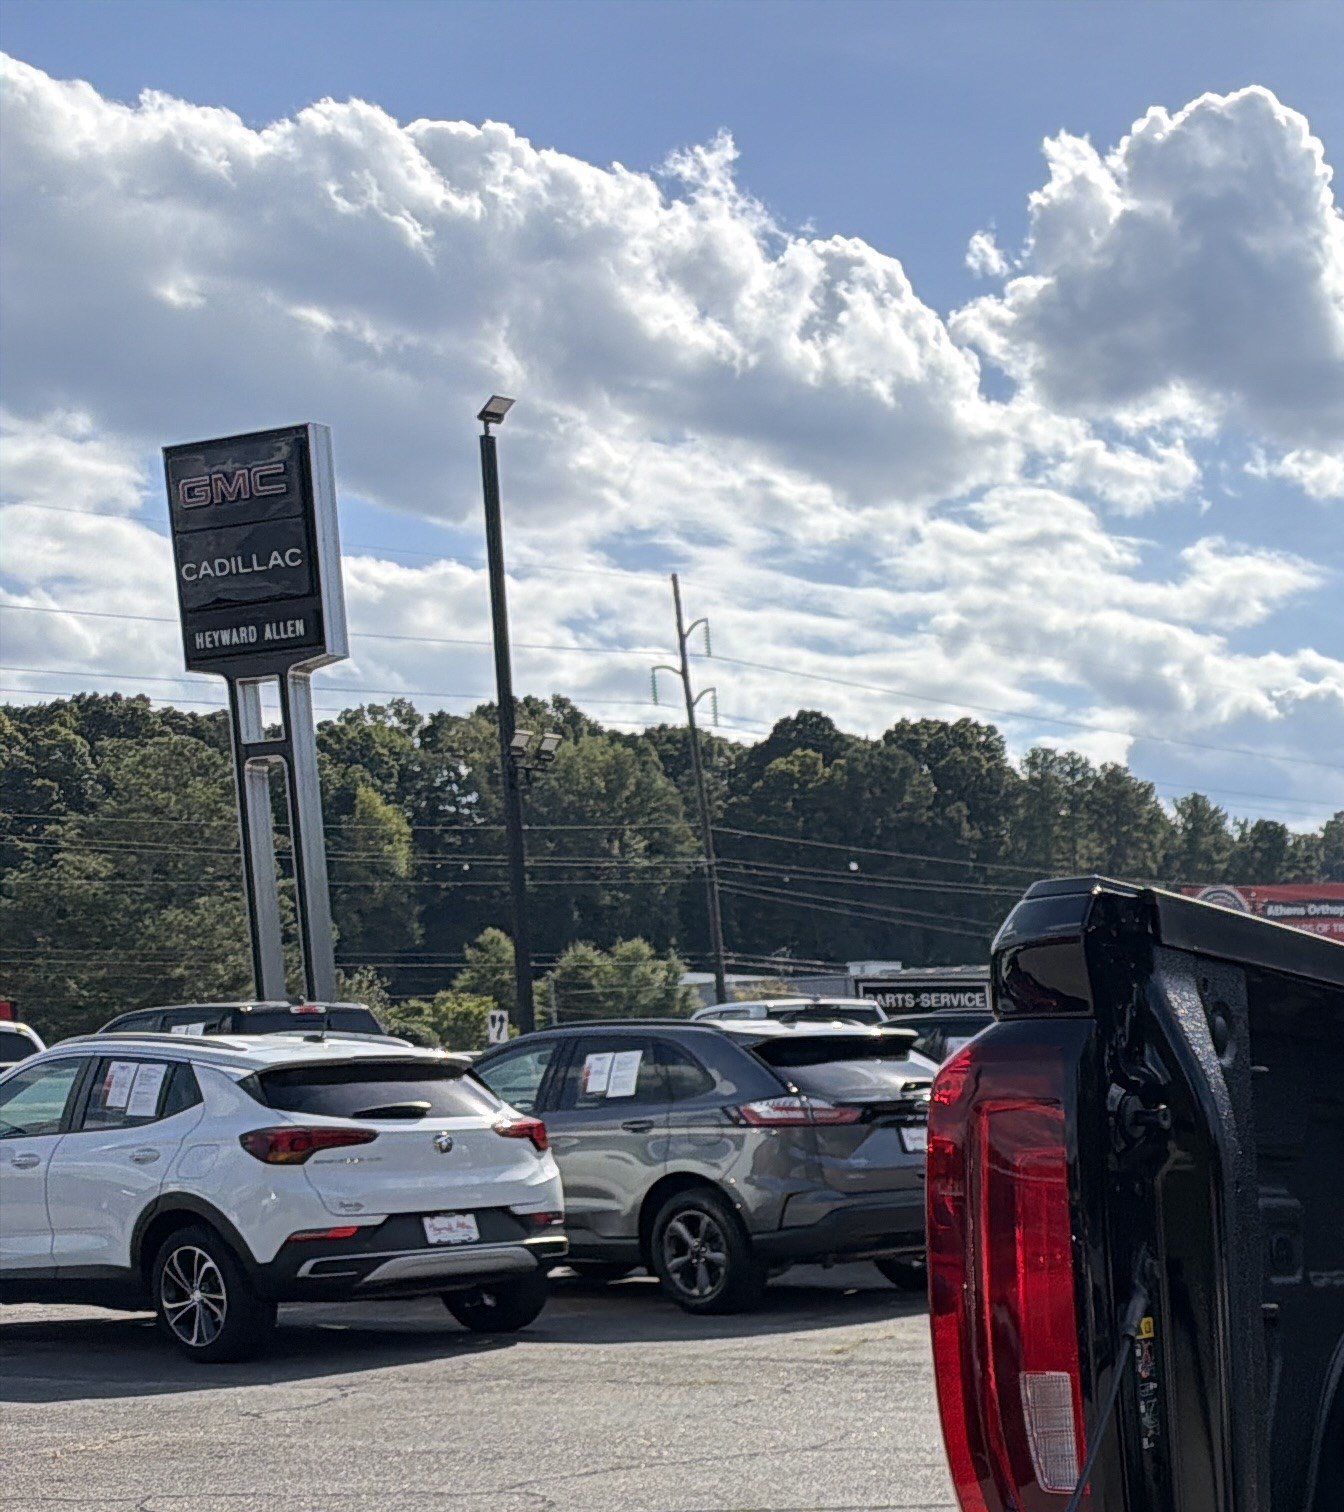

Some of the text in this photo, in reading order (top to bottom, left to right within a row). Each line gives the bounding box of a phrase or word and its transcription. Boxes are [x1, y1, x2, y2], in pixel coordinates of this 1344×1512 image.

[178, 462, 287, 510] GMC
[180, 547, 303, 582] CADILLAC
[195, 618, 305, 650] HEYWARD ALLEN
[1267, 902, 1305, 916] Athens
[1316, 923, 1331, 934] OF
